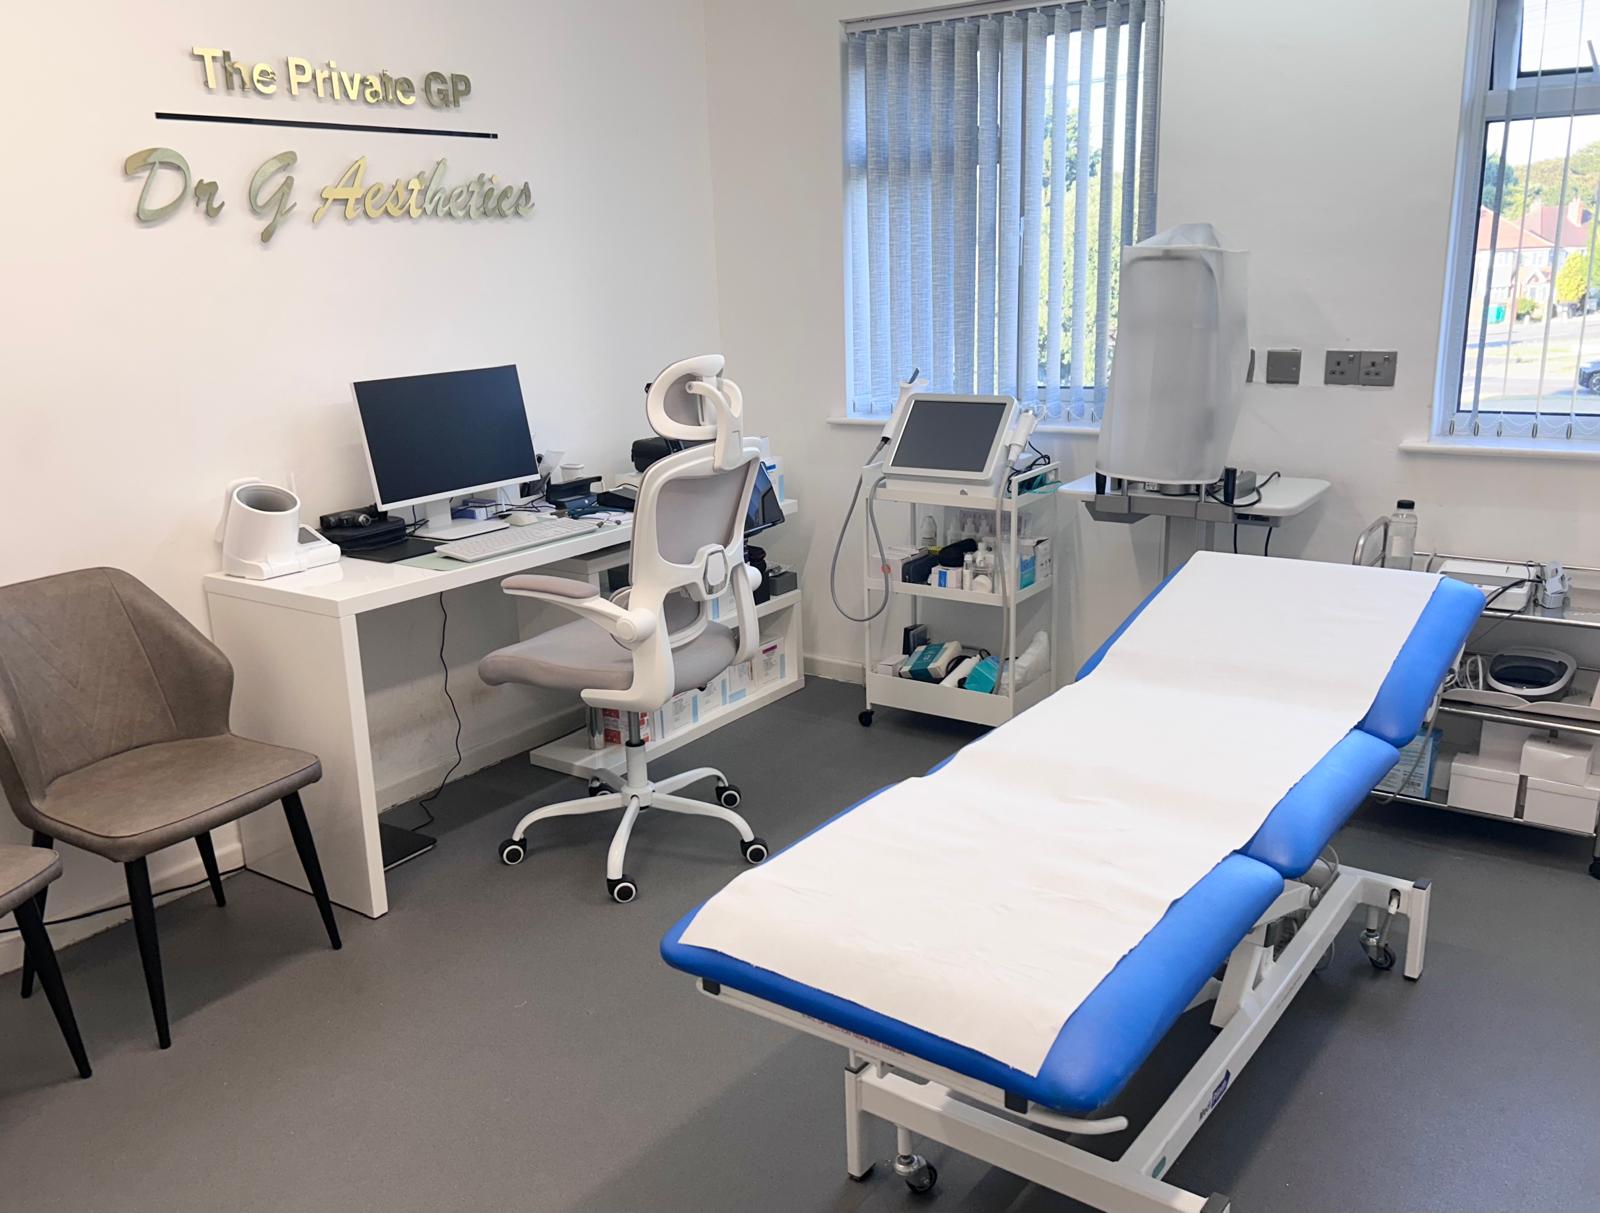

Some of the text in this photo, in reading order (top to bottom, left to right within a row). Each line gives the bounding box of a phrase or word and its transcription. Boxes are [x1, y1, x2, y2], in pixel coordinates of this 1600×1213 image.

[192, 47, 473, 109] The Private GP
[124, 147, 536, 244] Dr G Aesthetics
